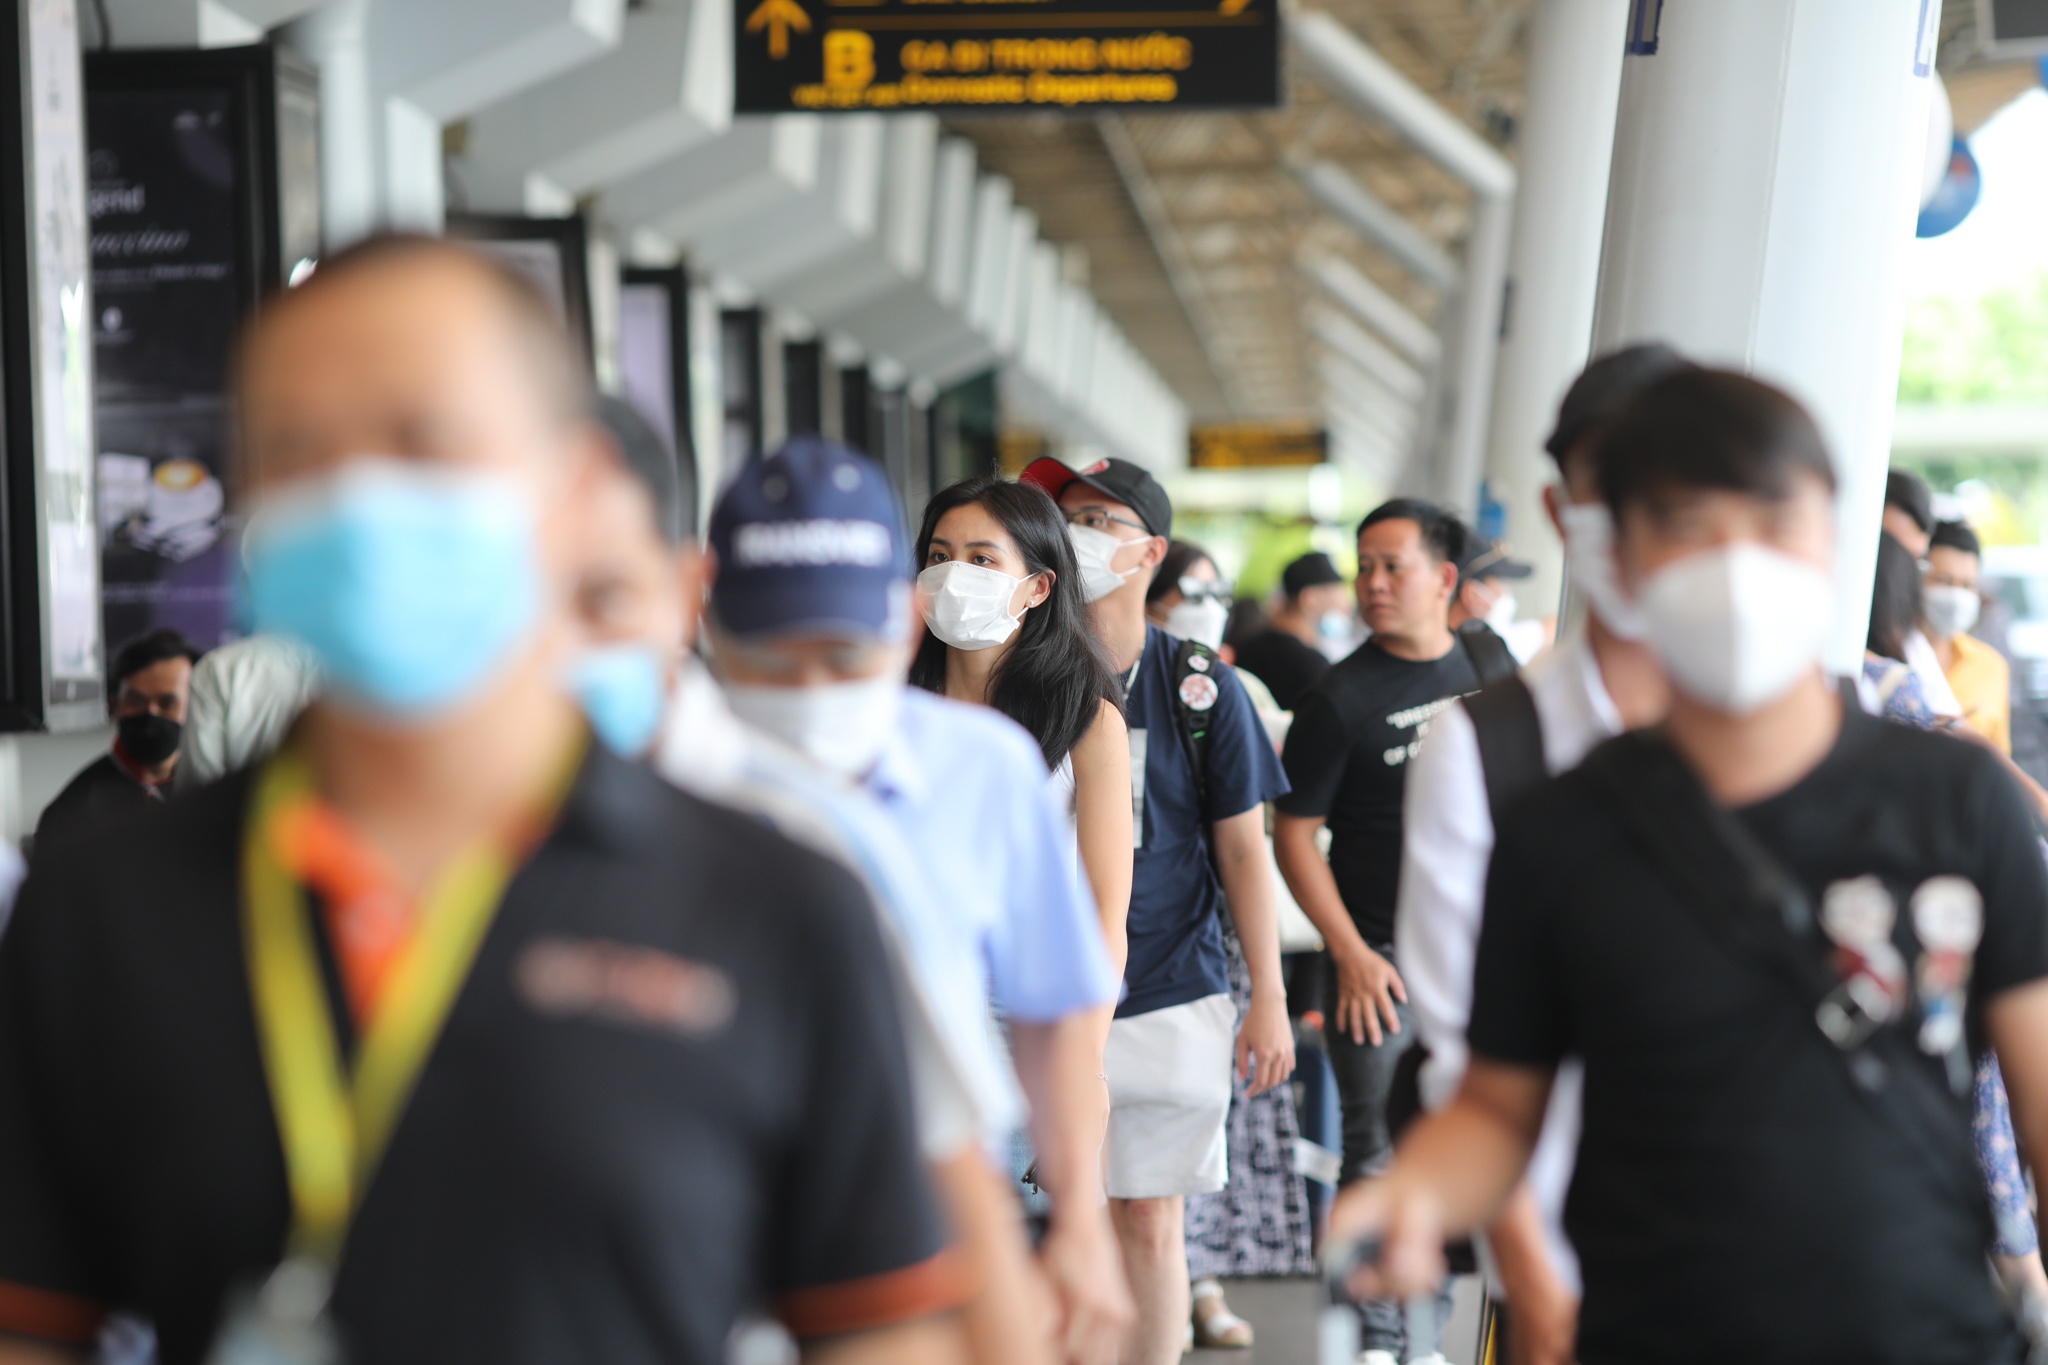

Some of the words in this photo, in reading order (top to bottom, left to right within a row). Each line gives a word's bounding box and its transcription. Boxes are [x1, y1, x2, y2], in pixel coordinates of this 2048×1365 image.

[824, 29, 876, 87] B
[900, 39, 948, 72] GA
[992, 37, 1099, 71] TRONG
[901, 73, 1025, 103] Domestic
[1026, 72, 1177, 106] Departures
[1383, 746, 1407, 766] OF
